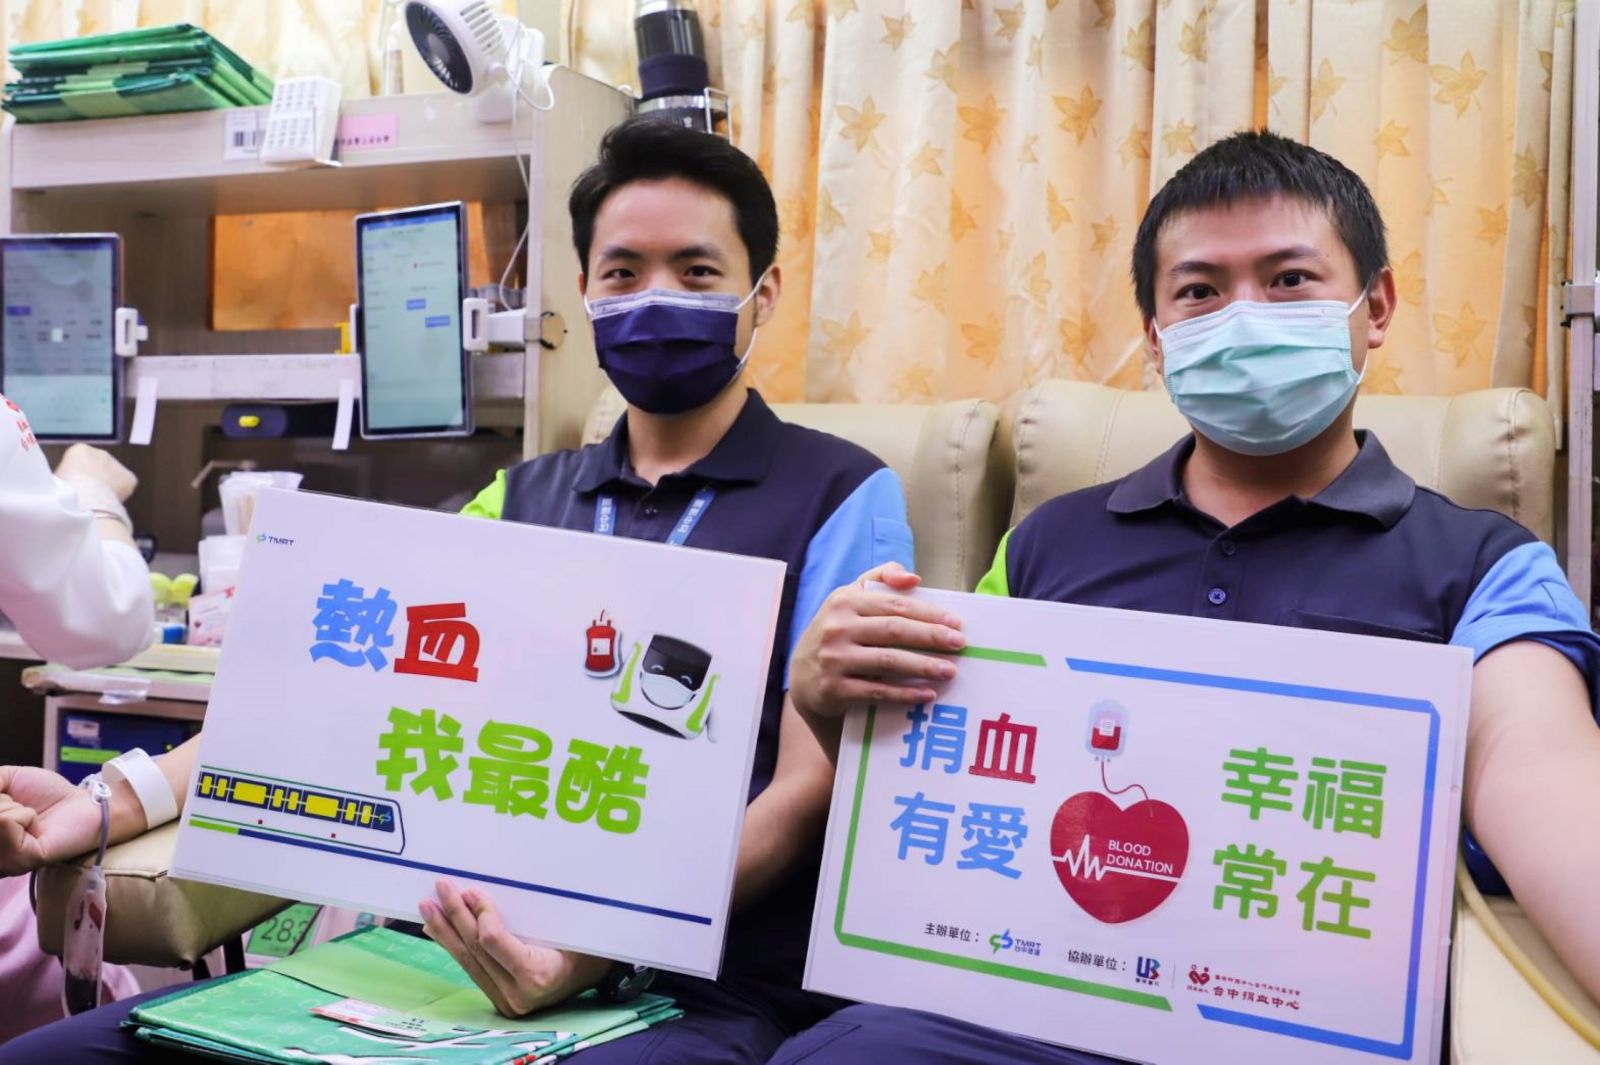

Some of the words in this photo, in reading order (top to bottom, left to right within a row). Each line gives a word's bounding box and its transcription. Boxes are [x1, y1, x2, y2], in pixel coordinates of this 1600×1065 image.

[309, 578, 480, 683] 熱血
[375, 706, 650, 835] 我最酷
[899, 702, 1037, 785] 捐血
[1221, 747, 1387, 839] 幸福
[889, 791, 1029, 880] 有愛
[1106, 853, 1174, 875] DONATION
[1108, 839, 1152, 856] BLOOD
[924, 922, 980, 943] 主辦單位：
[1213, 843, 1376, 940] 常在
[1067, 949, 1127, 972] 協辦單位：
[1212, 985, 1301, 1011] 台中捐血中心
